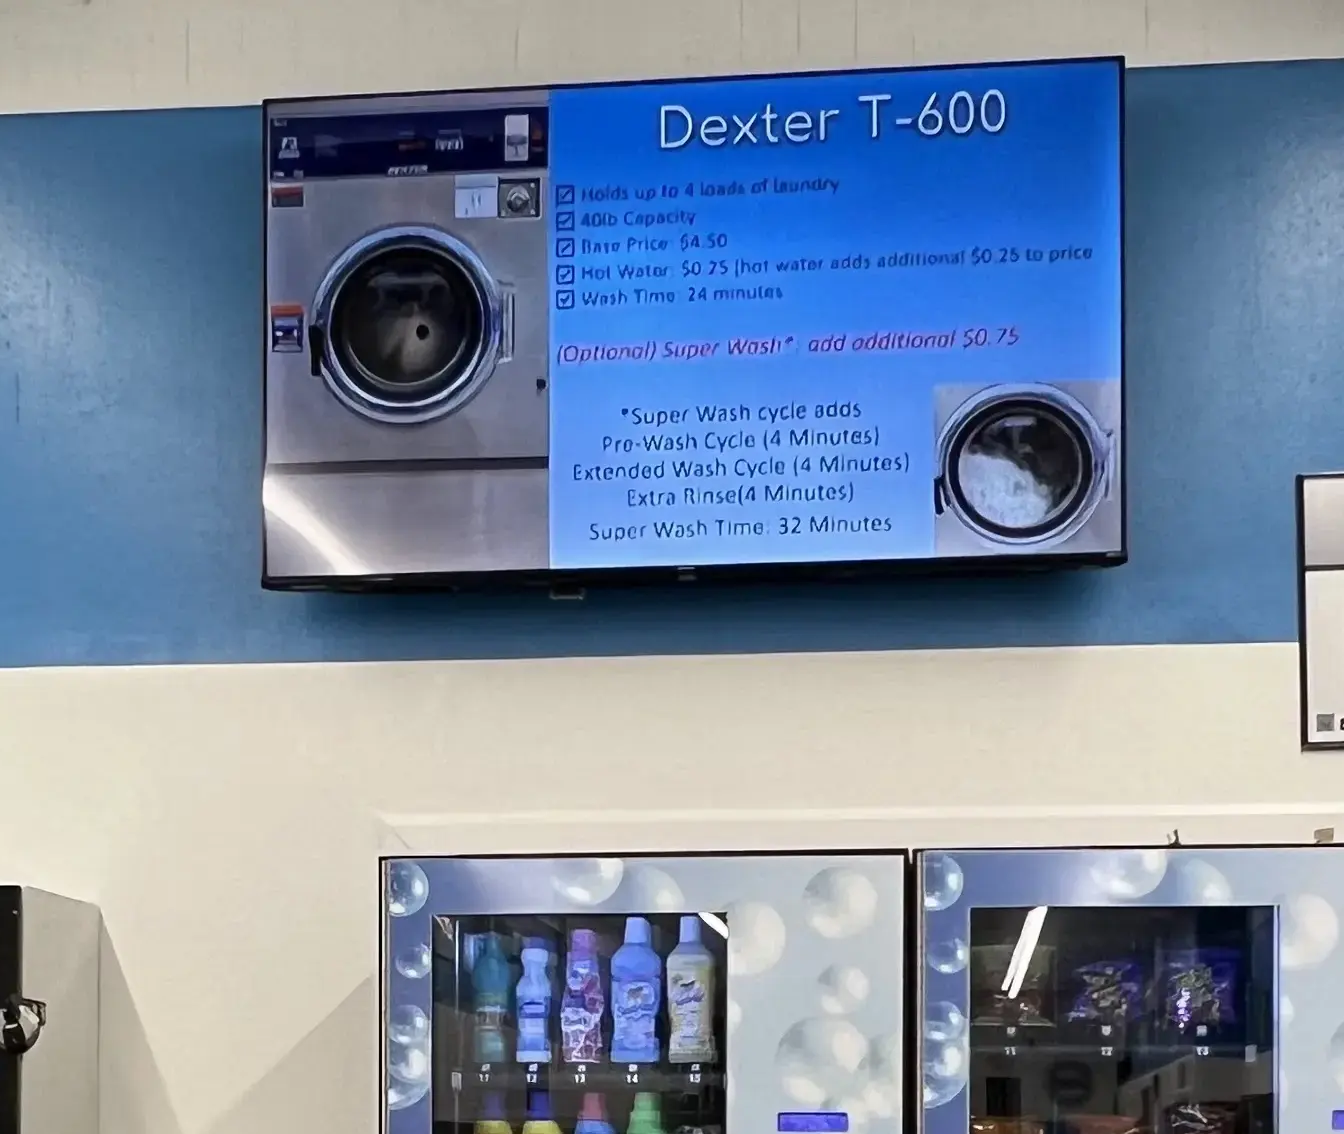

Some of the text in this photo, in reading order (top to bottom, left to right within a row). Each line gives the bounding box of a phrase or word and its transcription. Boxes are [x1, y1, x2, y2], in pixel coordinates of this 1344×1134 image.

[660, 89, 1006, 149] Dexter T-600
[581, 176, 841, 202] Holds up to 4 loads of laundry
[581, 209, 697, 230] 40lb Capacity
[581, 237, 620, 255] Base
[680, 232, 729, 252] $4.50
[581, 264, 612, 281] Hot
[776, 258, 824, 273] water
[830, 253, 871, 271] adds
[877, 249, 965, 268] additional
[971, 245, 1020, 267] $0.25
[1025, 247, 1044, 263] to
[1049, 244, 1094, 265] price
[582, 289, 628, 307] Wash
[688, 286, 707, 302] 24
[713, 284, 785, 301] minutes
[557, 340, 657, 366] (Optional)
[663, 340, 721, 361] Super
[808, 333, 847, 353] add
[852, 330, 956, 352] additional
[963, 326, 1021, 350] $0.75
[697, 403, 751, 424] Wash
[758, 400, 807, 425] cycle
[815, 400, 863, 420] adds
[603, 426, 881, 454] Pre-Wash Cycle (4 Minutes)
[573, 452, 911, 482] Extended Wash Cycle (4 Minutes)
[627, 482, 855, 508] Extra Rinse(4 Minutes)
[589, 515, 894, 544] Super Wash Time: 32 Minutes
